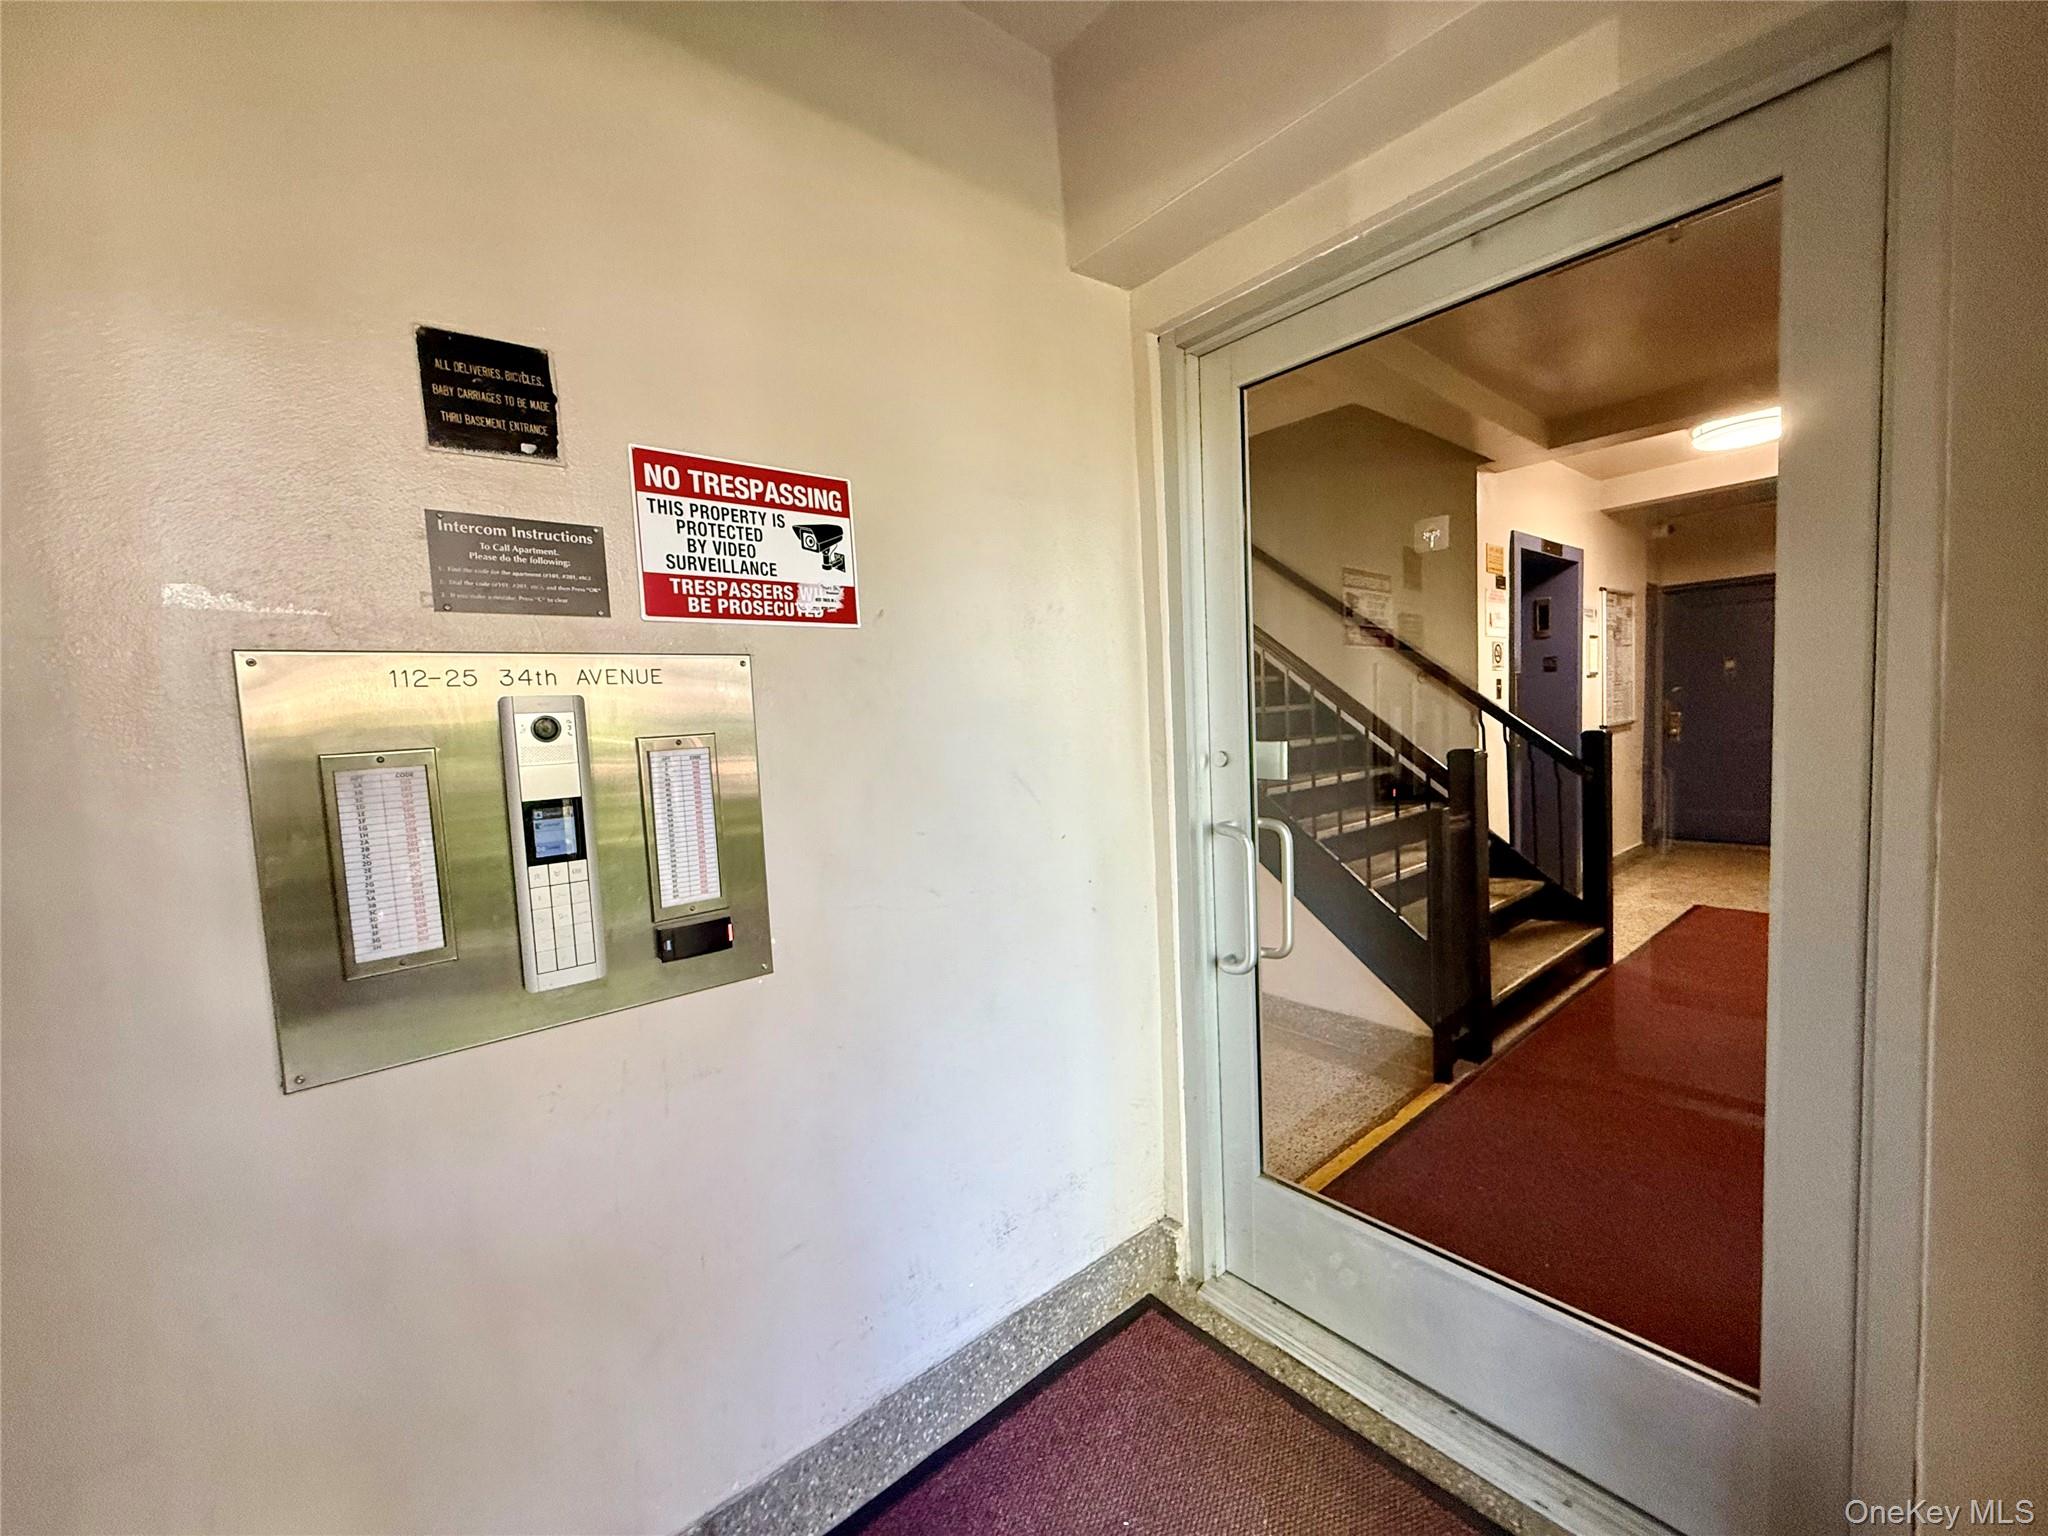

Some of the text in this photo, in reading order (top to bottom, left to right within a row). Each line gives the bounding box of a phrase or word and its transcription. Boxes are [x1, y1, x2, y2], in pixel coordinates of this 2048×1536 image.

[434, 358, 450, 371] ALL
[432, 384, 550, 412] BABY CARRIAGES TO BE MADE
[440, 410, 548, 436] THRU BASEMENT ENTRANCE
[643, 462, 843, 512] NO TRESPASSING
[646, 498, 786, 528] THIS PROPERTY IS
[438, 518, 594, 545] Intercom Instructions
[676, 519, 763, 542] PROTECTED
[468, 552, 497, 562] Please
[499, 554, 511, 562] do
[514, 554, 527, 563] the
[480, 542, 490, 550] To
[492, 543, 510, 552] Call
[686, 538, 756, 558] BY VIDEO
[666, 554, 778, 577] SURVEILLANCE
[669, 578, 794, 600] TRESPASSERS
[688, 598, 712, 614] BE
[389, 668, 663, 688] 112-25 34th AVENUE
